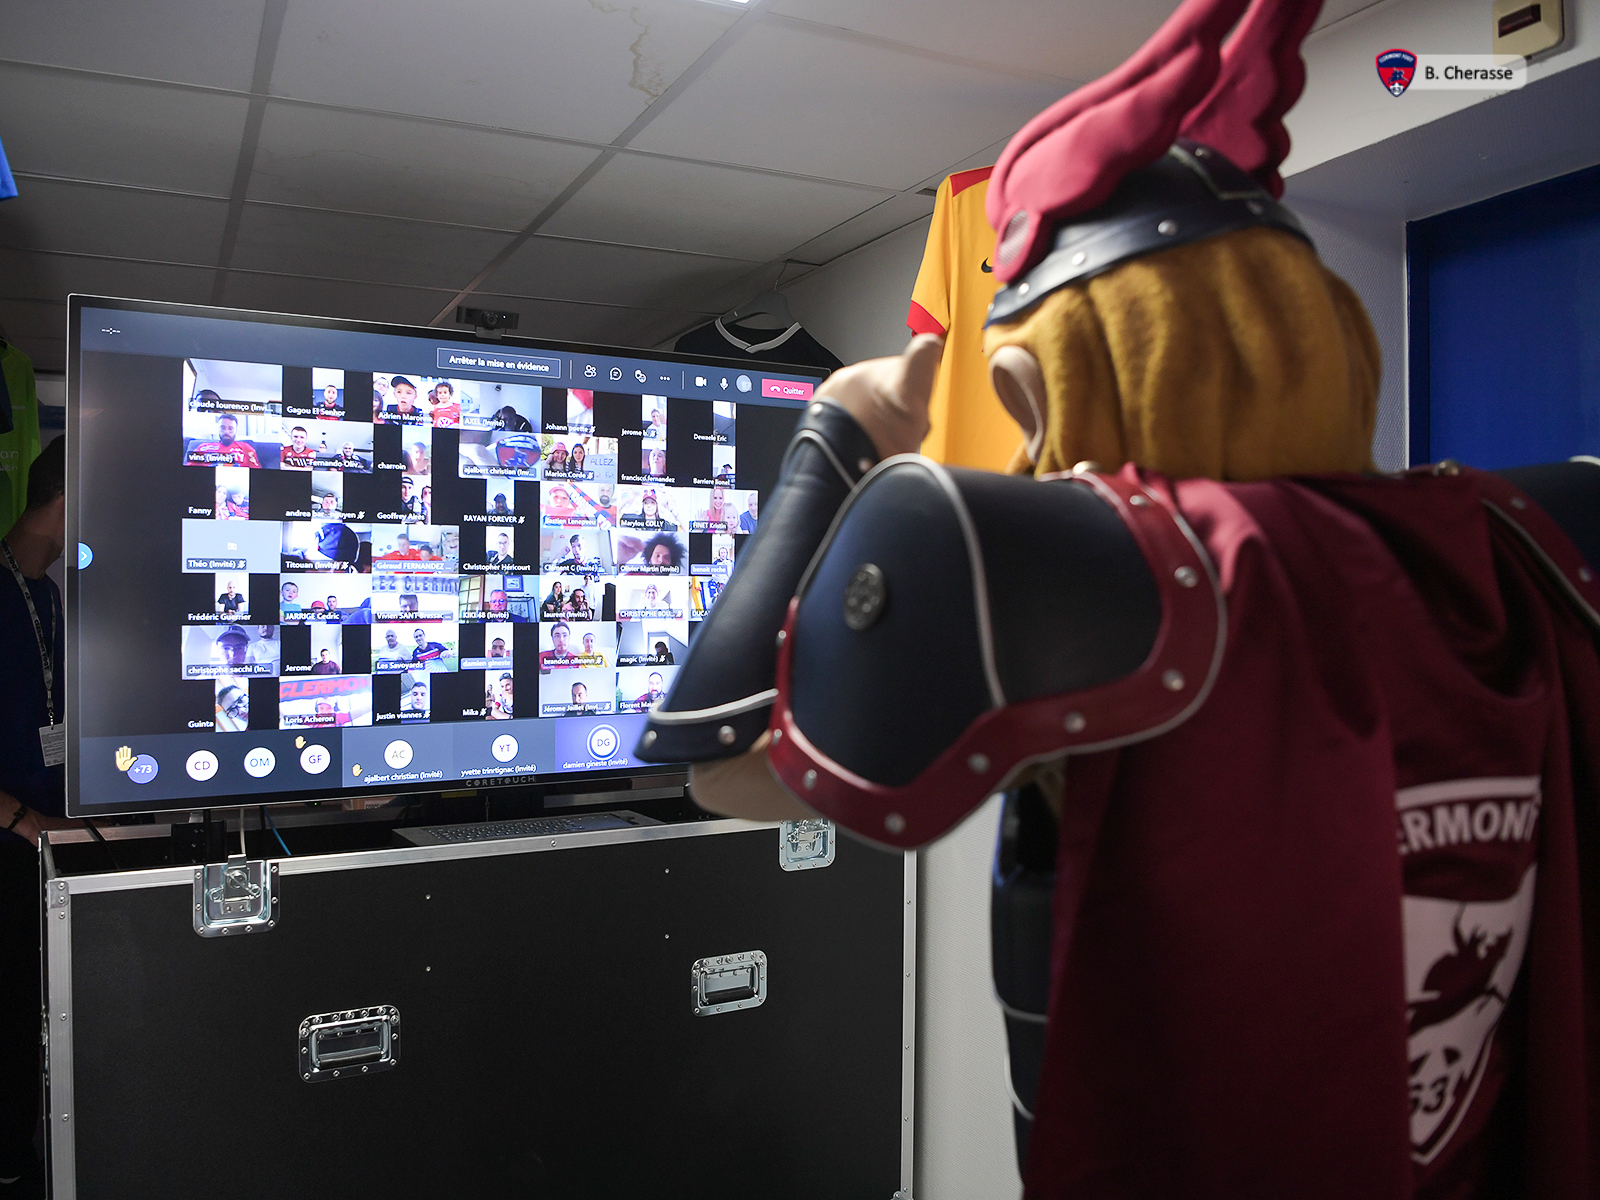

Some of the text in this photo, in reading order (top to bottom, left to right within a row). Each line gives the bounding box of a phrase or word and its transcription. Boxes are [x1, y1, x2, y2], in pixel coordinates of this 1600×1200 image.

[449, 355, 475, 366] Arrêter
[478, 358, 484, 366] la
[486, 359, 503, 368] mise
[517, 361, 549, 372] évidence
[783, 387, 804, 396] Quitter
[190, 400, 215, 408] claude
[216, 401, 250, 411] lourenço
[286, 406, 310, 416] Gagou
[320, 408, 346, 417] Senhor
[378, 412, 401, 420] Adrien
[206, 455, 233, 464] (Invité)
[378, 462, 406, 470] charroin
[464, 468, 489, 476] ajalbert
[490, 468, 516, 476] christian
[545, 470, 566, 478] Marion
[621, 474, 646, 482] francisco
[188, 506, 212, 516] Fanny
[377, 512, 407, 520] Geoffrey
[464, 514, 517, 524] RAYAN FOREVER
[620, 520, 644, 528] Marylou
[646, 520, 664, 528] COLLY
[188, 560, 236, 570] Théo (Invité)
[286, 560, 340, 570] Titouan (Invité)
[377, 562, 444, 570] Géraud FERNANDEZ
[462, 563, 531, 572] Christopher Héricourt
[544, 564, 569, 572] Clément
[576, 564, 598, 572] (Invité)
[660, 566, 680, 574] (Invité)
[188, 612, 251, 621] Frédéric Guerrier
[285, 612, 340, 621] JARRIGE Cedric
[377, 612, 398, 620] Vivien
[544, 611, 588, 620] laurent (Invité)
[620, 610, 657, 618] CHRISTOPHE
[462, 659, 511, 669] damien gineste
[544, 657, 570, 665] brandon
[620, 656, 638, 664] magic
[188, 666, 229, 675] christophe
[230, 666, 252, 674] sacchi
[285, 664, 312, 672] Jerome
[377, 661, 424, 671] Les Savoyards
[544, 704, 566, 713] Jérome
[567, 704, 584, 712] Jaillet
[286, 715, 334, 724] Loris Acheron
[376, 712, 393, 721] justin
[188, 720, 214, 728] Guinta
[597, 738, 610, 748] DG
[499, 744, 510, 752] YT
[392, 750, 406, 759] AC
[250, 758, 270, 768] OM
[308, 755, 322, 764] GF
[562, 758, 628, 770] damien gineste (Invité)
[134, 765, 152, 774] +73
[194, 762, 210, 770] CD
[460, 768, 480, 778] yvette
[515, 764, 536, 774] (Invité)
[364, 770, 443, 784] ajalbert christian (Invité)
[466, 776, 535, 787] CORETOUCH
